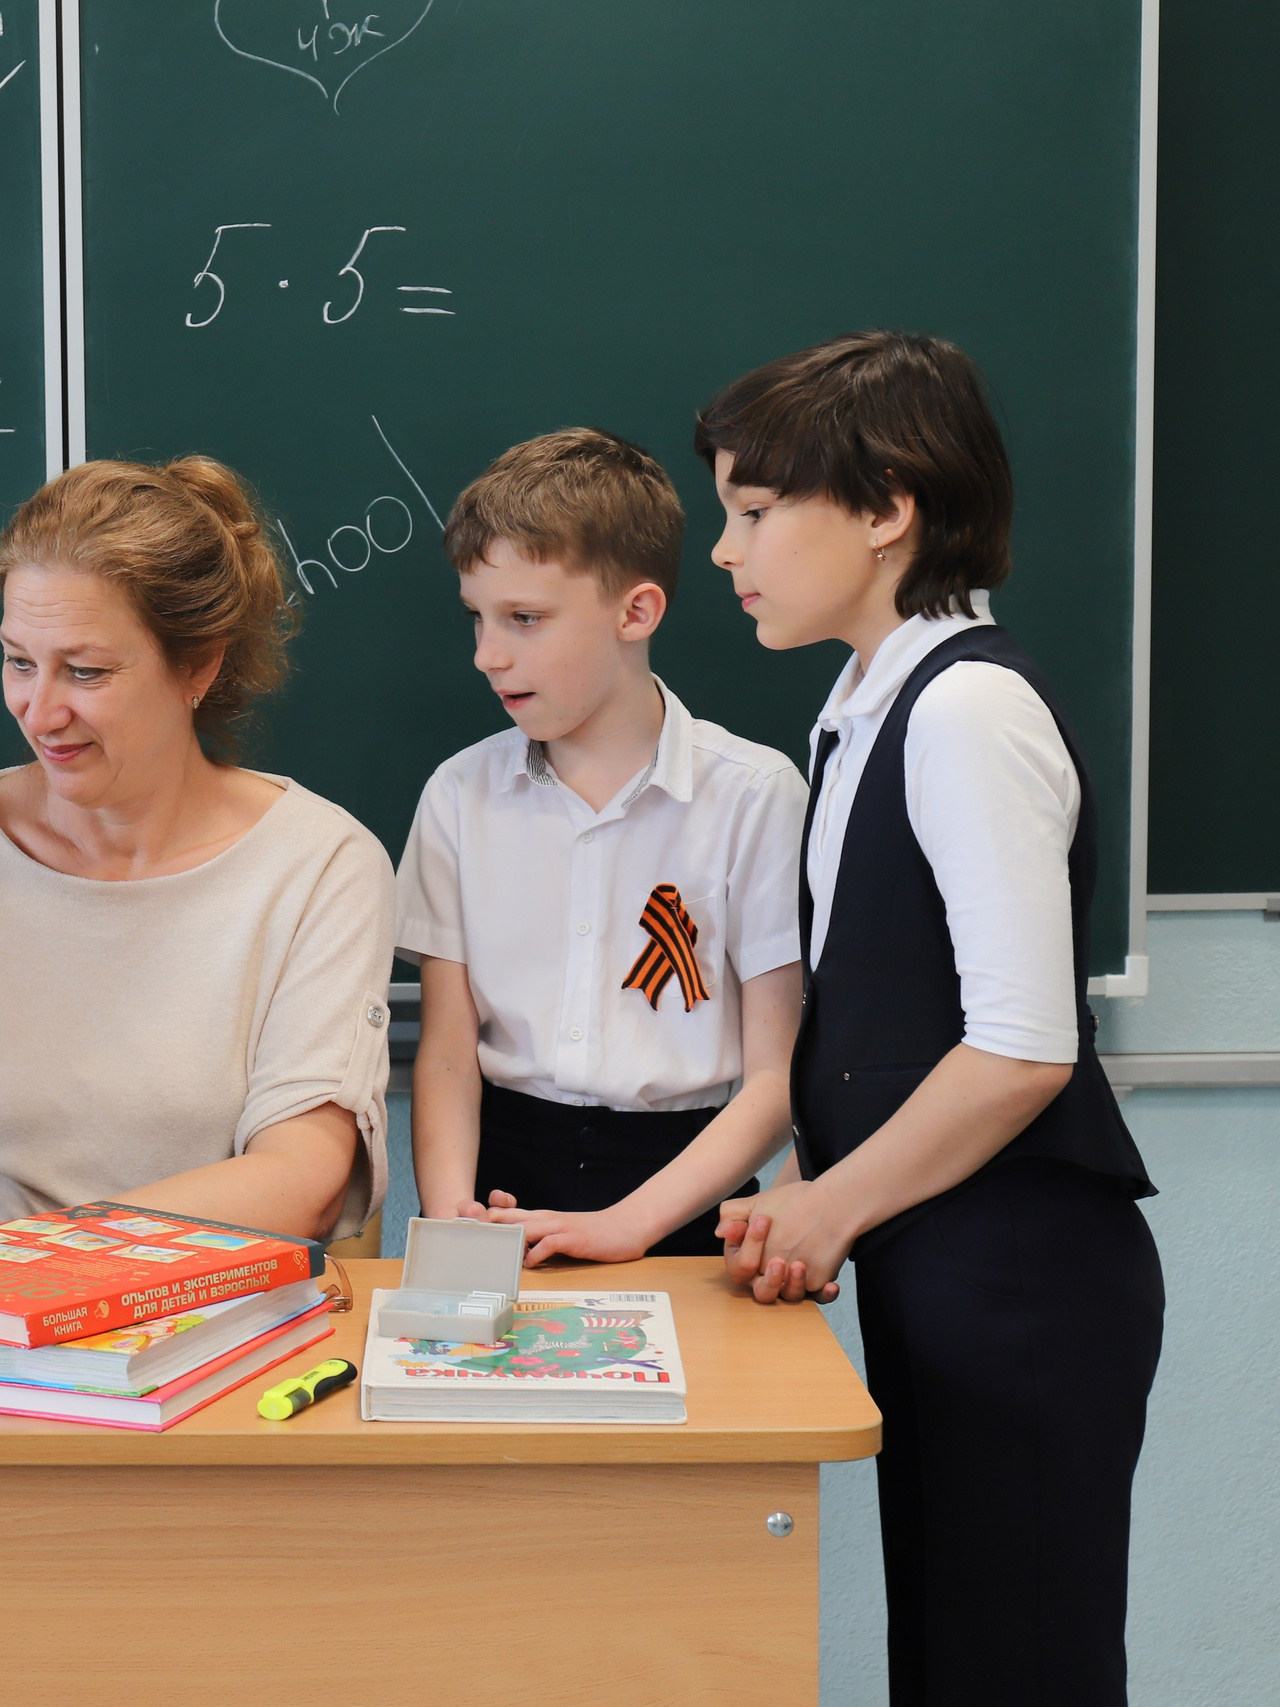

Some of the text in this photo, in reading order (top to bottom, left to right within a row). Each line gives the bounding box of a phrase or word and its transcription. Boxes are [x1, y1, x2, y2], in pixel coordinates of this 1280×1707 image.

[120, 1258, 278, 1307] ОПЫТОВ И ЭКСПЕРИМЕНТОВ
[133, 1273, 271, 1319] ДЛЯ ДЕТЕЙ И ВЗРОСЛЫХ
[42, 1306, 88, 1327] БОЛЬШАЯ
[54, 1322, 83, 1336] КНИГА
[405, 1363, 670, 1383] Почемучка
